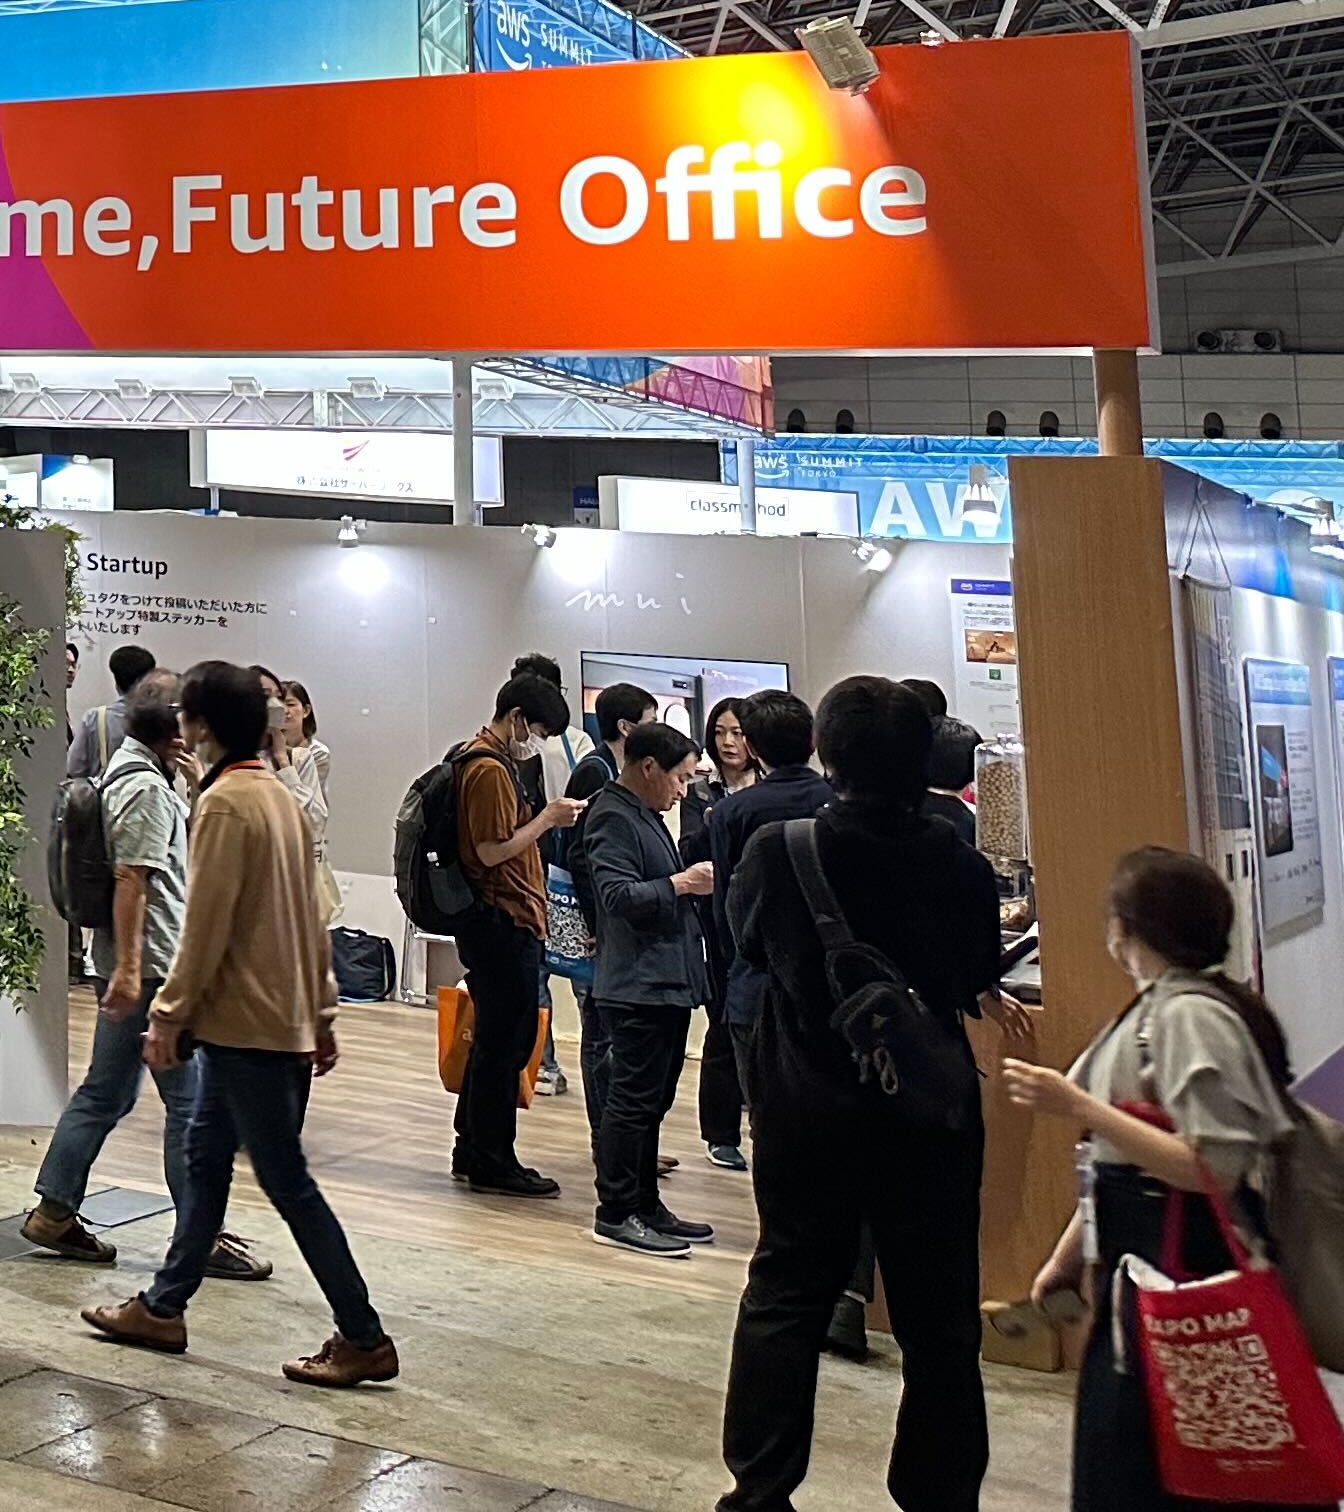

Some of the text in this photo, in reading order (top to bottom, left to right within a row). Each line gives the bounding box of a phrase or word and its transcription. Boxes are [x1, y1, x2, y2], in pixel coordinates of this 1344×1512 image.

[496, 0, 593, 65] aws SUMMIT
[558, 140, 929, 246] Office
[690, 498, 787, 517] classmhod
[86, 552, 168, 580] Startup
